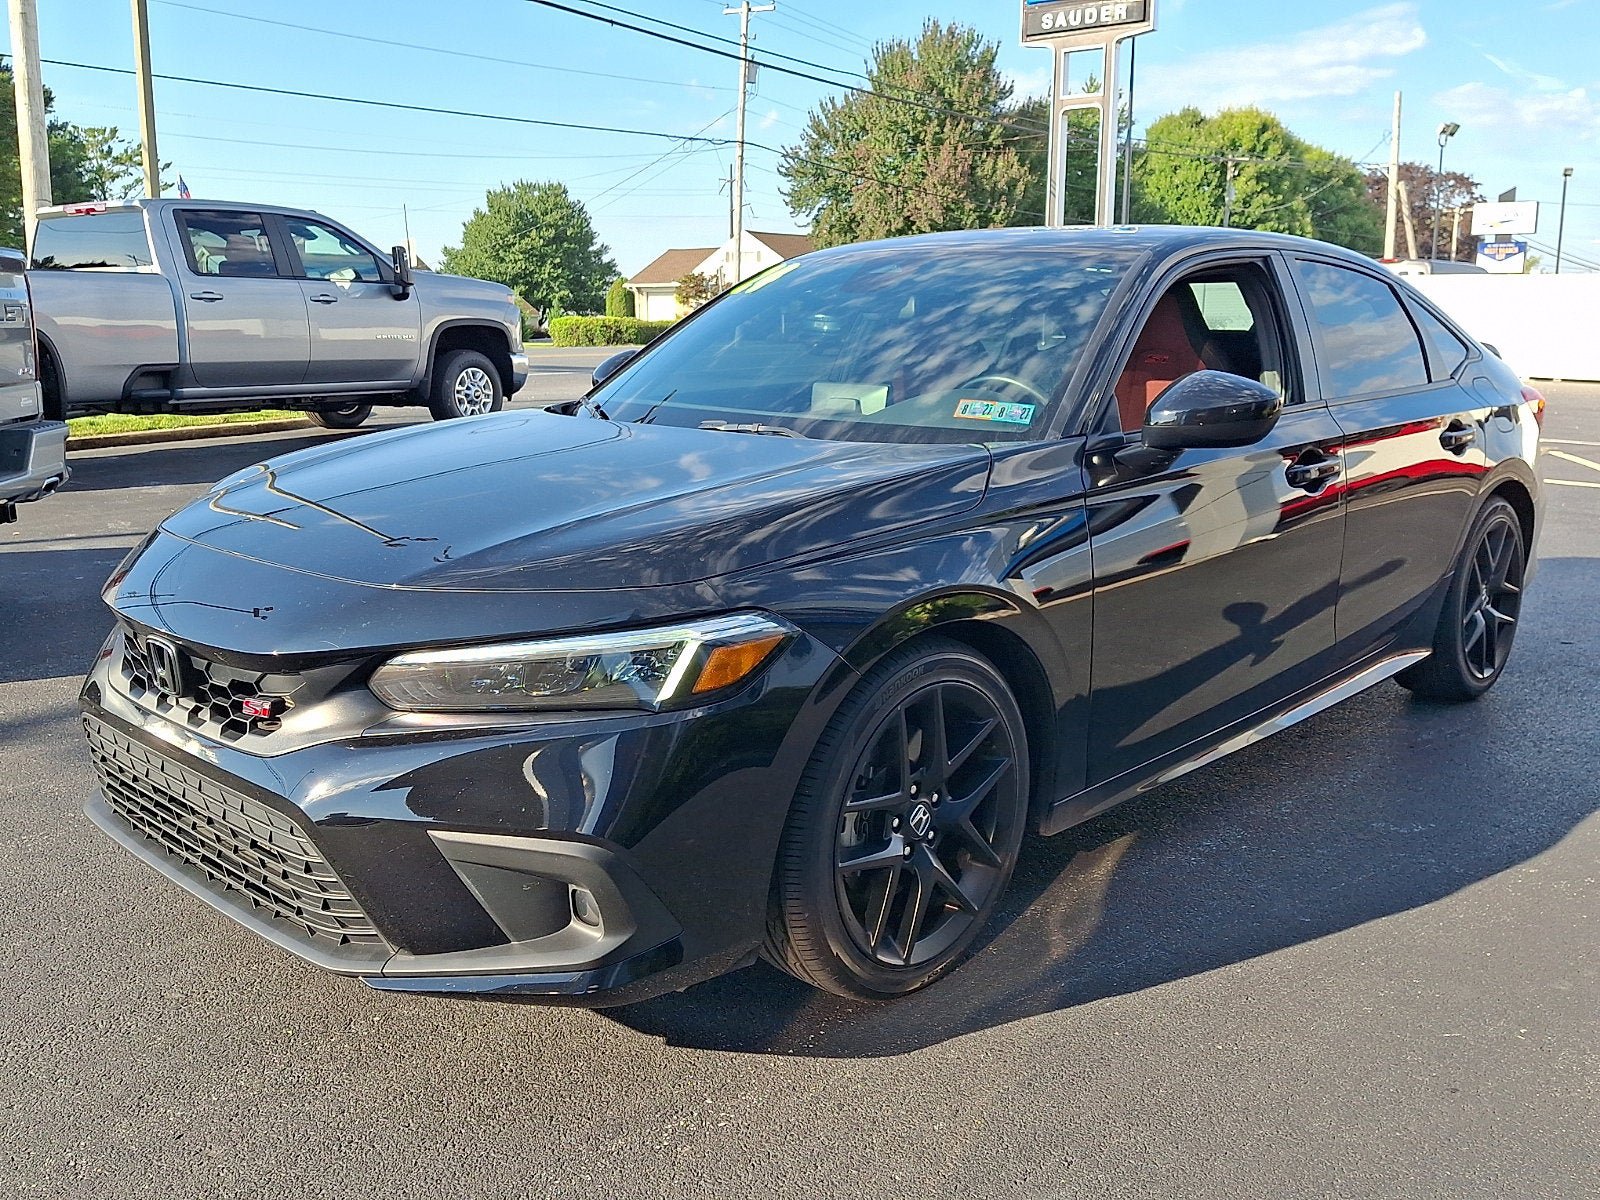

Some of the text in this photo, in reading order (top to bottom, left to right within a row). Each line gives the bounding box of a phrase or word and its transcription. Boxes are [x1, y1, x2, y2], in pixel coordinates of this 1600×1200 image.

[1041, 4, 1128, 30] SAUDER
[961, 404, 969, 415] 8
[982, 403, 993, 415] 27
[998, 407, 1006, 418] 8
[1020, 407, 1031, 419] 27
[243, 698, 271, 718] Si
